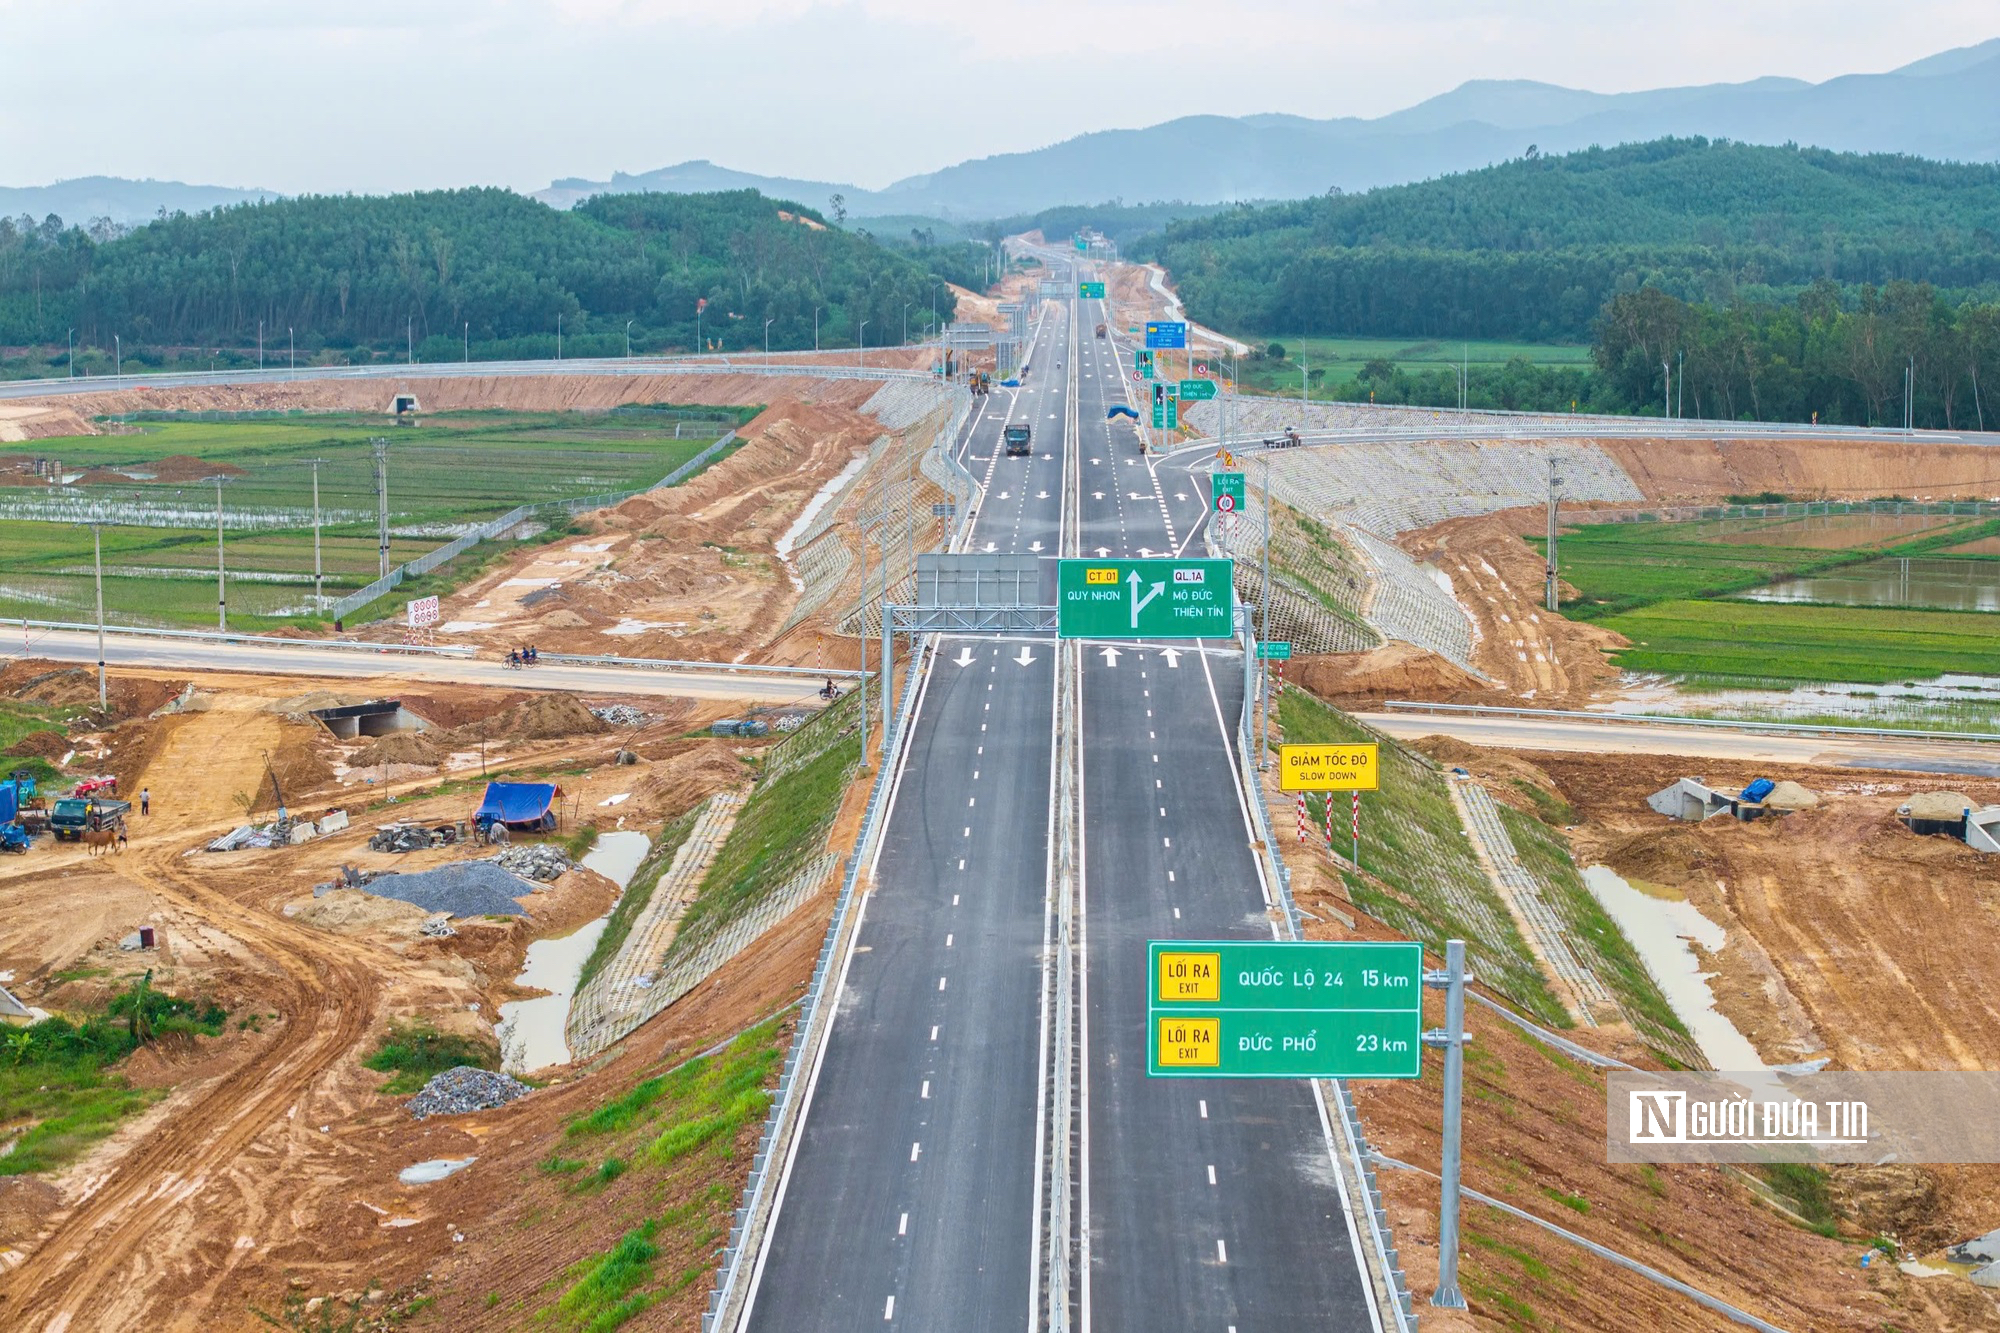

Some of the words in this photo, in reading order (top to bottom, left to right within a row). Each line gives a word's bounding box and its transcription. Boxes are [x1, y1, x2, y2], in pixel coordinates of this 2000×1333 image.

[1175, 571, 1203, 582] QL.1A
[1068, 591, 1088, 600] QUY
[1092, 590, 1120, 600] NHƠN
[1173, 590, 1188, 602] MỘ
[1192, 588, 1213, 600] ĐỨC
[1174, 605, 1202, 618] THIỆN
[1207, 604, 1223, 616] TÍN
[1291, 752, 1319, 766] GIẢM
[1325, 750, 1347, 766] TỐC
[1351, 752, 1367, 767] ĐỘ
[1300, 772, 1325, 780] SLOW
[1330, 772, 1356, 780] DOWN
[1168, 959, 1187, 978] LỐI
[1193, 964, 1210, 978] RA
[1239, 966, 1284, 987] QUỐC
[1294, 968, 1314, 990] LỘ
[1324, 972, 1344, 987] 24
[1362, 969, 1379, 987] 15
[1384, 973, 1409, 987] km
[1180, 983, 1199, 994] EXIT
[1168, 1024, 1187, 1043] LỐI
[1193, 1030, 1210, 1043] RA
[1239, 1032, 1273, 1051] ĐỨC
[1283, 1029, 1317, 1052] PHỔ
[1357, 1035, 1378, 1052] 23
[1383, 1038, 1408, 1052] km
[1179, 1048, 1198, 1059] EXIT
